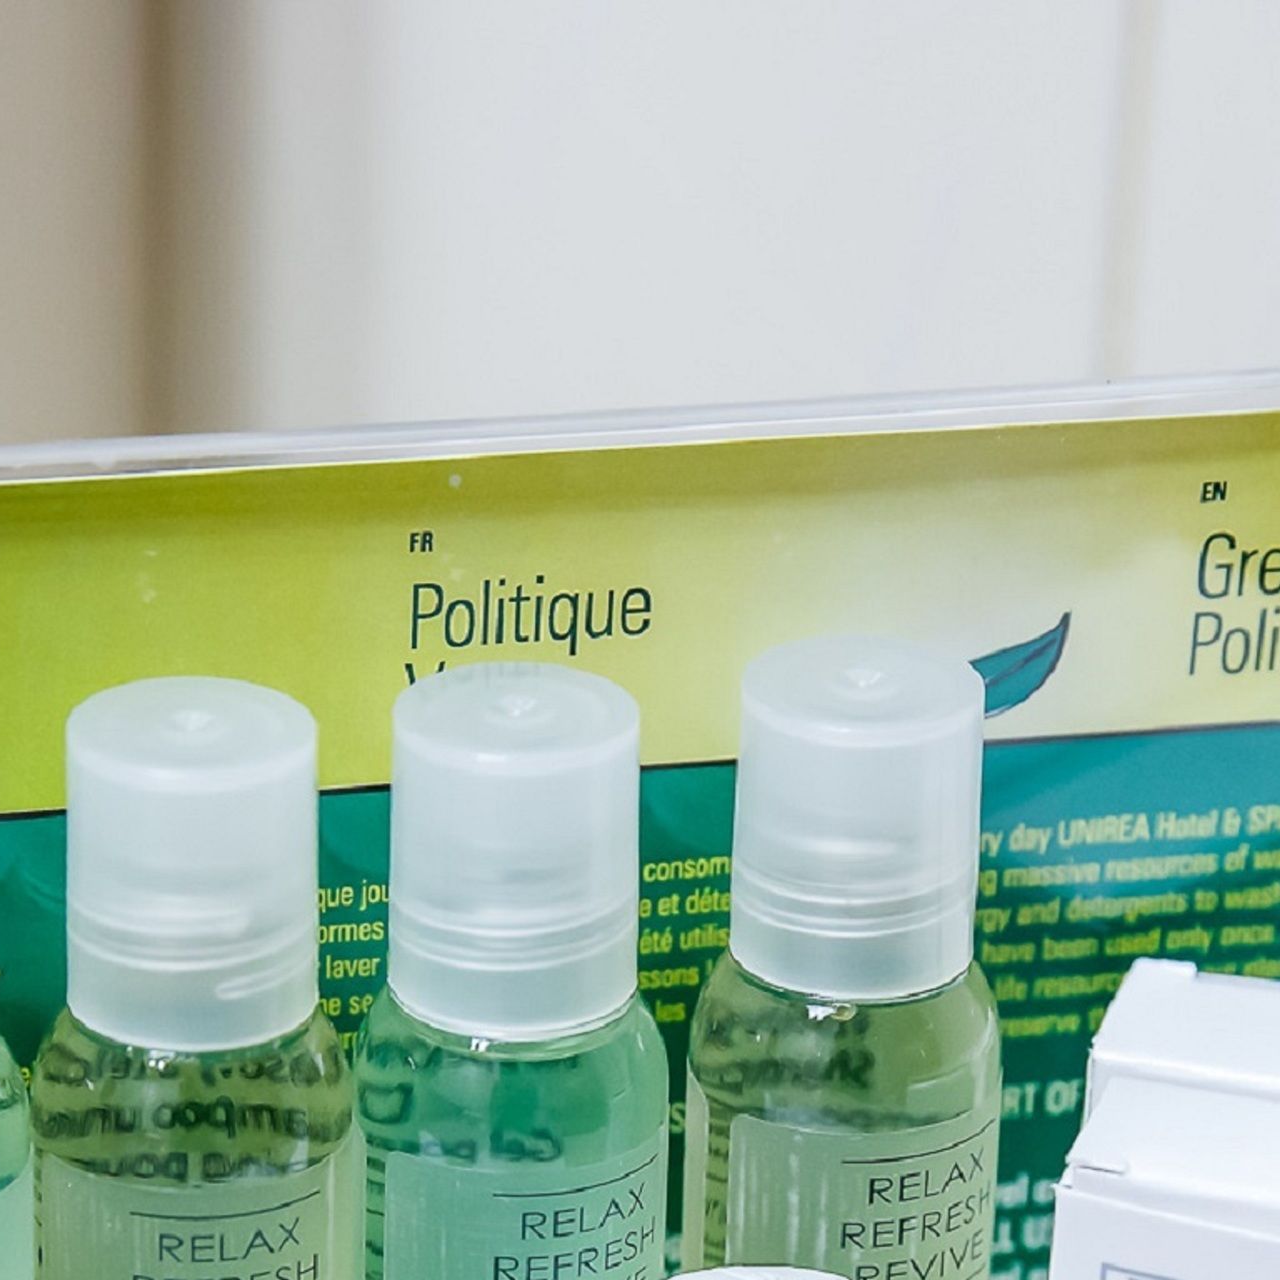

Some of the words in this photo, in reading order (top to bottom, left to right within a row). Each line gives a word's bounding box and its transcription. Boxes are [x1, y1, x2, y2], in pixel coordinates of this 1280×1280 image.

[1200, 481, 1228, 503] EN
[409, 531, 433, 553] FR
[410, 575, 652, 656] Politique
[1009, 822, 1052, 855] day
[1058, 813, 1150, 847] UNIREA
[1155, 809, 1219, 840] Hotel
[1003, 858, 1101, 888] massive
[1105, 853, 1219, 882] resources
[1224, 842, 1250, 872] of
[1017, 896, 1061, 926] and
[1066, 892, 1188, 924] detergents
[326, 955, 381, 979] laver
[869, 1149, 985, 1206] RELAX
[521, 1183, 645, 1241] RELAX
[840, 1187, 992, 1250] REFRESH
[158, 1217, 300, 1263] RELAX
